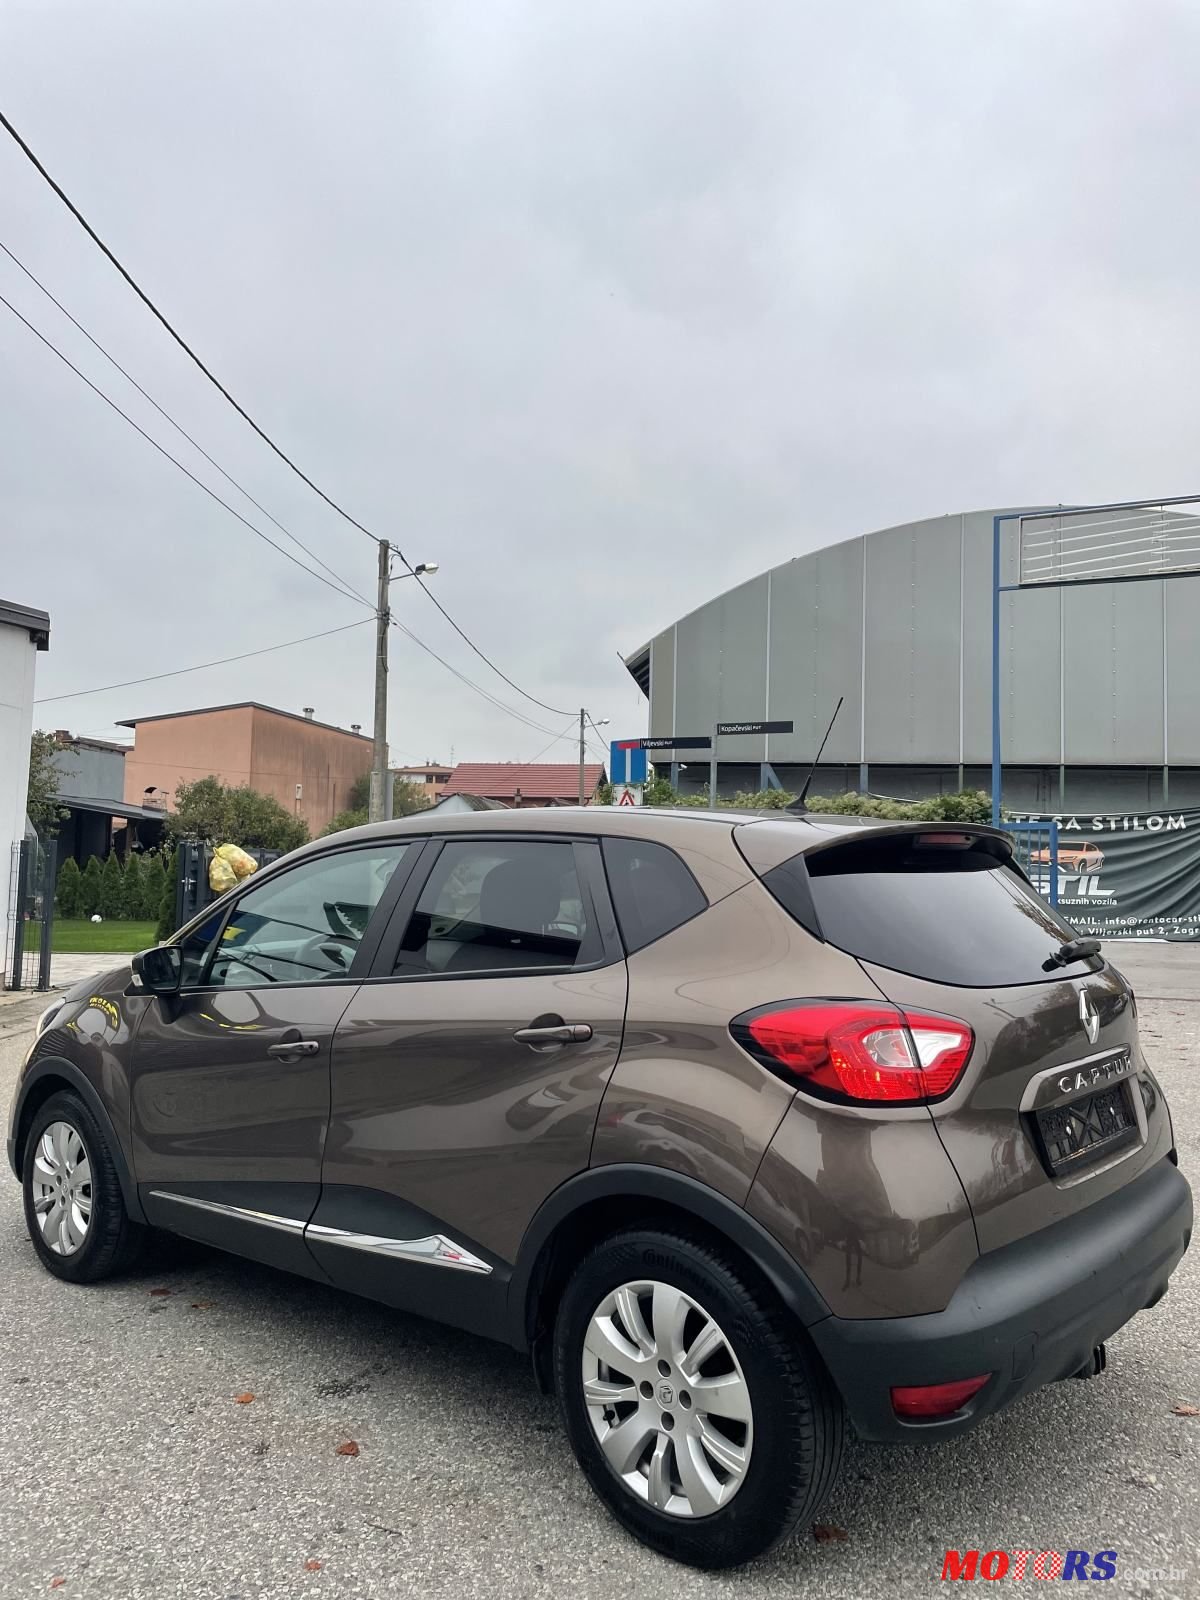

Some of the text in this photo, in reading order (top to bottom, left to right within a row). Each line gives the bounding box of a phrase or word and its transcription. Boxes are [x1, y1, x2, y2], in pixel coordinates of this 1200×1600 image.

[721, 725, 752, 733] Kopačevski
[642, 739, 664, 748] Viljevski
[1053, 816, 1081, 831] SA
[1092, 815, 1187, 831] STILOM
[1030, 874, 1116, 896] STIL
[1048, 897, 1118, 906] lksuznih vozila
[1136, 927, 1154, 936] put
[1158, 926, 1169, 936] 2,
[1173, 926, 1199, 936] Zagr
[1057, 1056, 1132, 1093] CAPTUR
